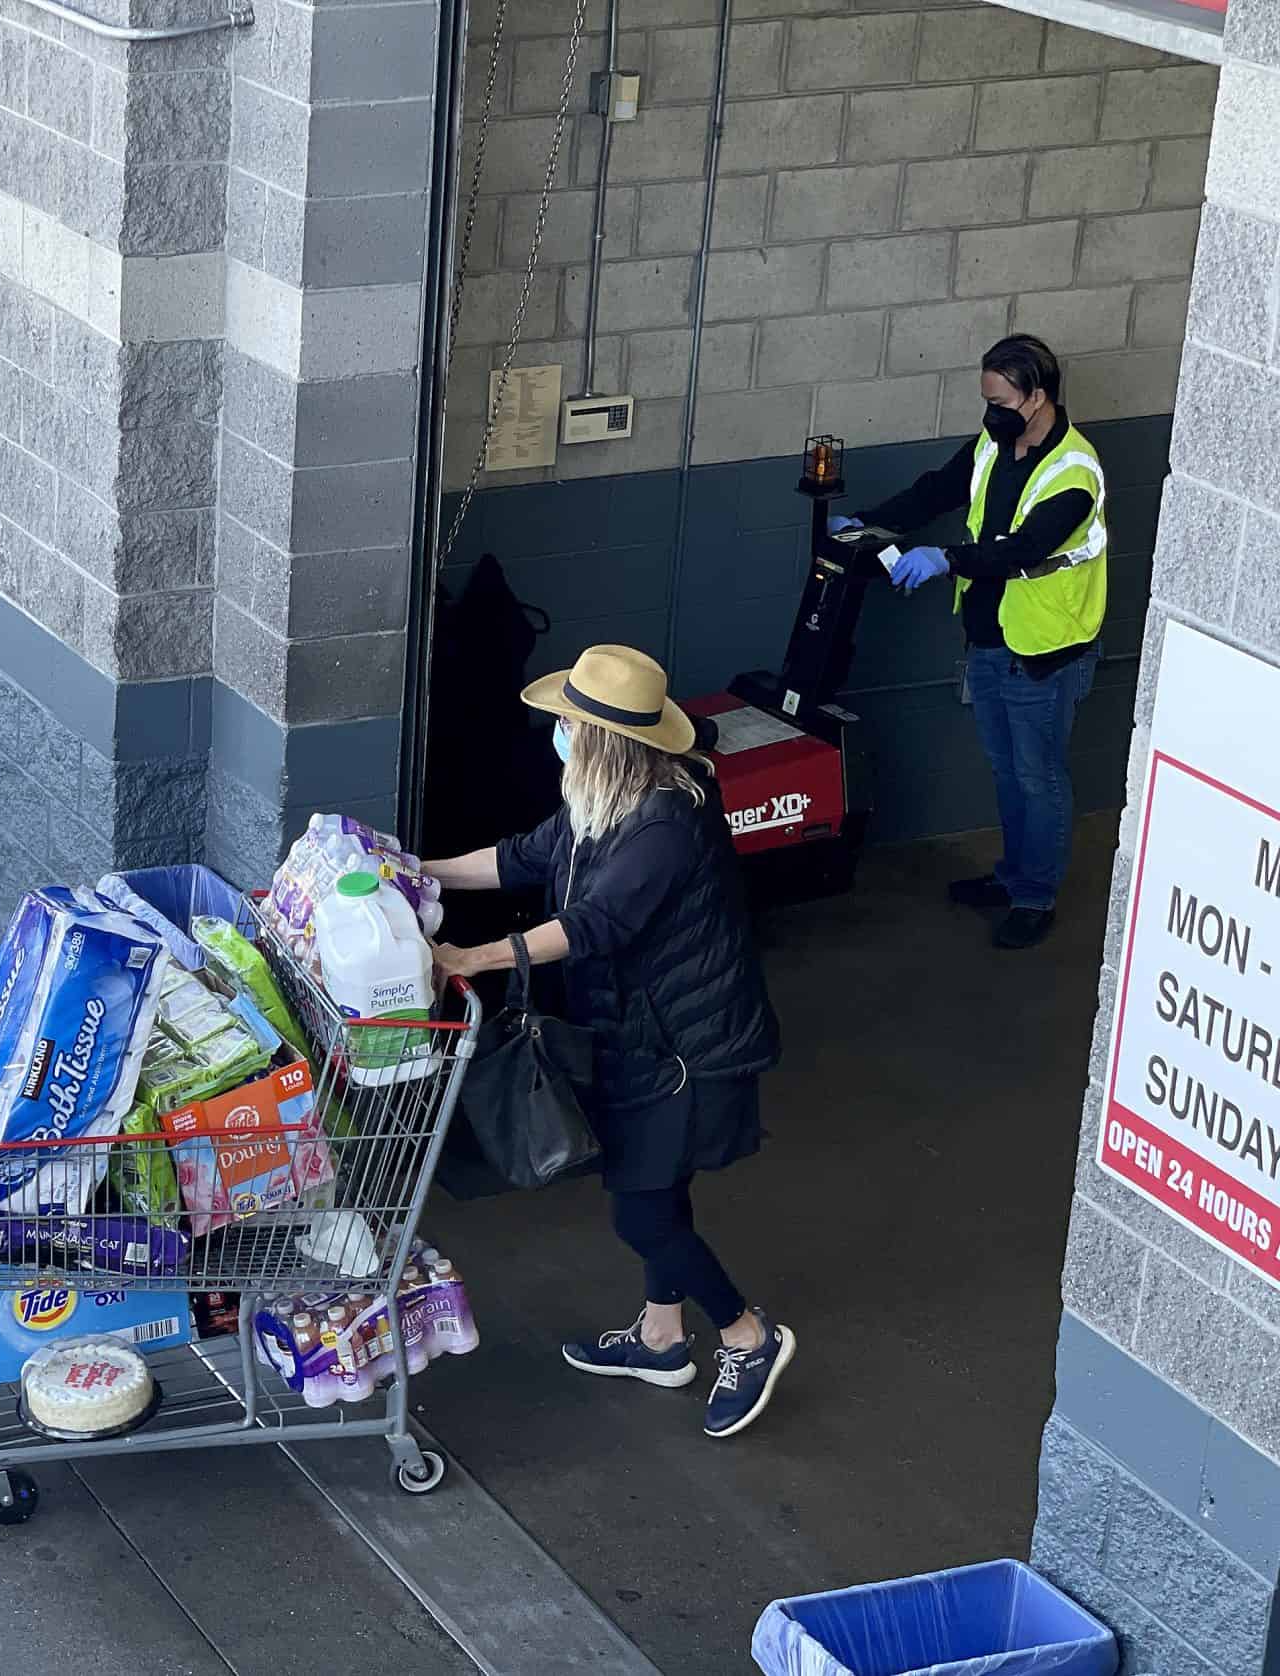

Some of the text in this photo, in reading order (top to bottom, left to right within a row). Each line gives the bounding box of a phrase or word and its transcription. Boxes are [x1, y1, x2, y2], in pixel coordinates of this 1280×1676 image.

[770, 793, 812, 819] XD+
[1167, 885, 1251, 975] MON
[373, 983, 414, 998] Simply
[54, 999, 105, 1081] Tissue
[23, 1040, 48, 1097] KIRKLAND
[280, 1070, 303, 1086] 110
[32, 1083, 81, 1150] Bath
[1108, 1120, 1272, 1250] OPEN 24 HOURS
[100, 1239, 120, 1250] CAT
[20, 1289, 69, 1323] Tide
